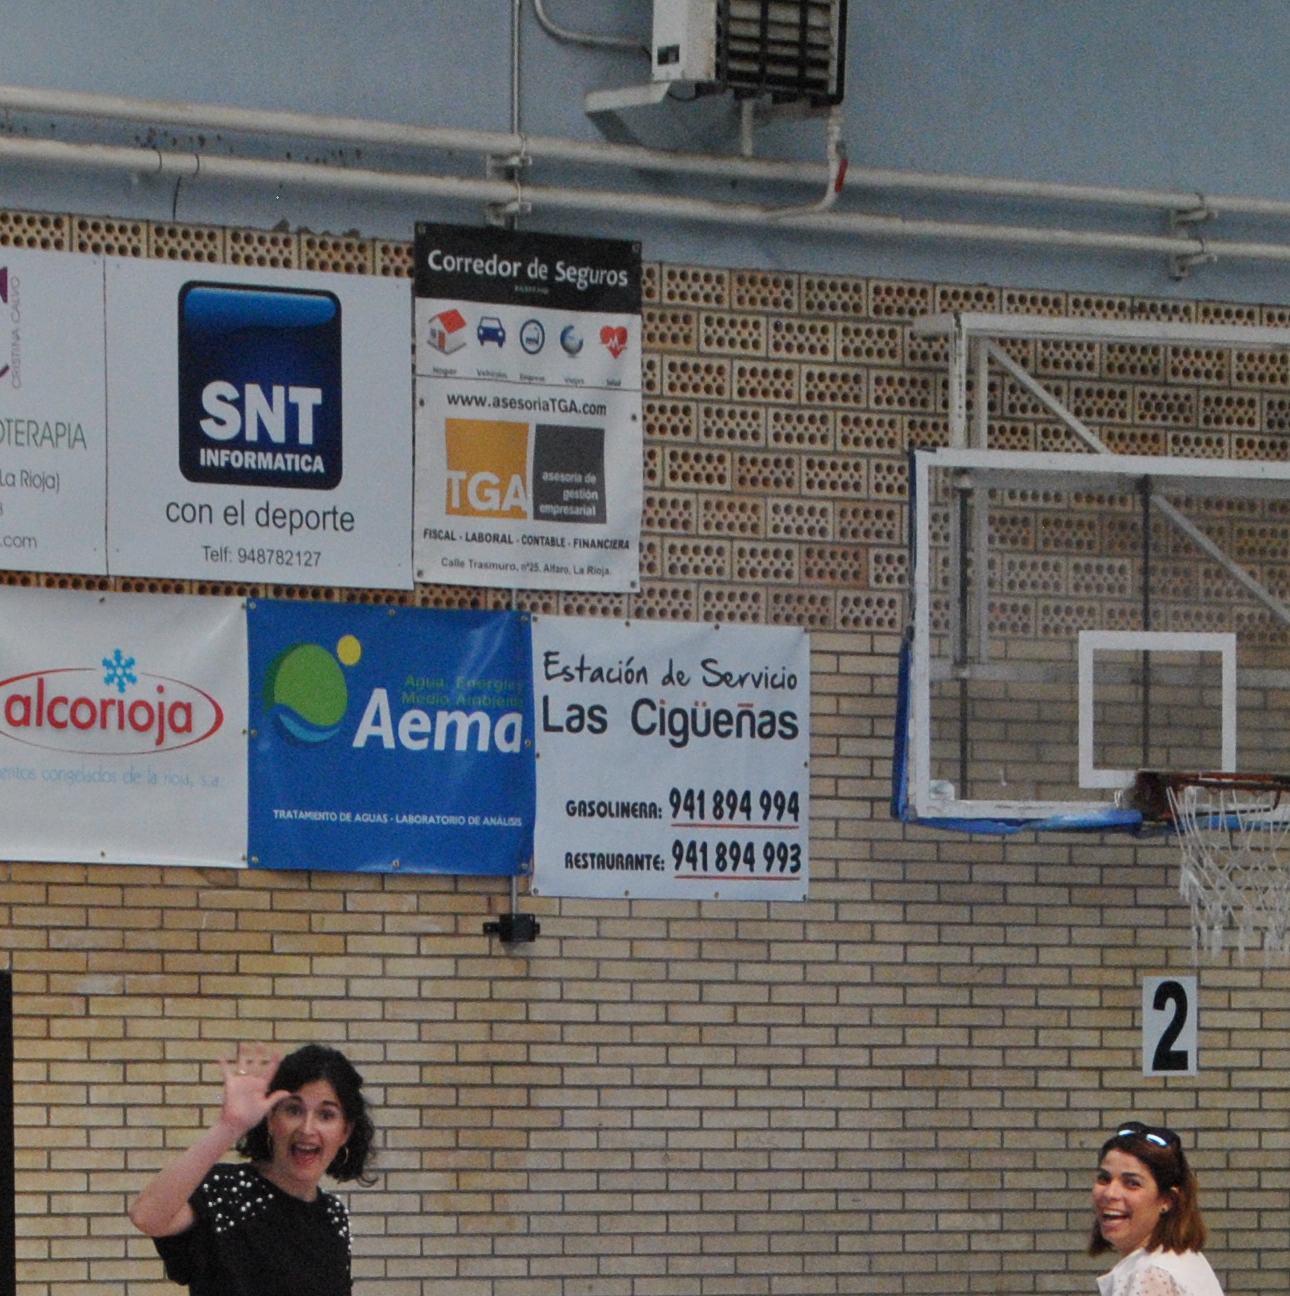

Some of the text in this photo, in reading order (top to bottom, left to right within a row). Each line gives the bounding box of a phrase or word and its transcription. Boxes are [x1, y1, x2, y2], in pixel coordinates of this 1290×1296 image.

[428, 250, 521, 278] Corredor
[527, 256, 548, 279] de
[555, 260, 628, 291] Seguros
[199, 380, 322, 445] SNT
[447, 393, 607, 416] www.asesoriaTGA.com
[199, 448, 325, 473] INFORMATICA
[20, 469, 60, 493] Rioja)
[446, 470, 527, 511] TGA
[585, 473, 597, 484] de
[165, 500, 355, 536] con el deporte
[539, 502, 596, 516] empresarial
[202, 545, 321, 567] Telf: 948782127
[423, 528, 630, 550] FISCAL LABORAL CONTABLE FINANCIERA
[441, 557, 465, 569] Calle
[574, 565, 585, 574] La
[543, 650, 798, 690] Estación de Servicio
[4, 677, 193, 746] alcorioja
[352, 688, 523, 753] Aema
[542, 695, 800, 748] Las Cigüeñas
[123, 765, 141, 785] de
[273, 809, 338, 822] TRATAMIENTO
[340, 811, 353, 823] DE
[354, 812, 388, 824] AGUAS
[395, 813, 466, 826] LABORATORIO
[468, 815, 480, 826] DE
[566, 787, 800, 823] GASOLINERA: 941 894 994
[565, 839, 802, 874] RESTAURANTE: 941 894 993
[1151, 980, 1189, 1072] 2
